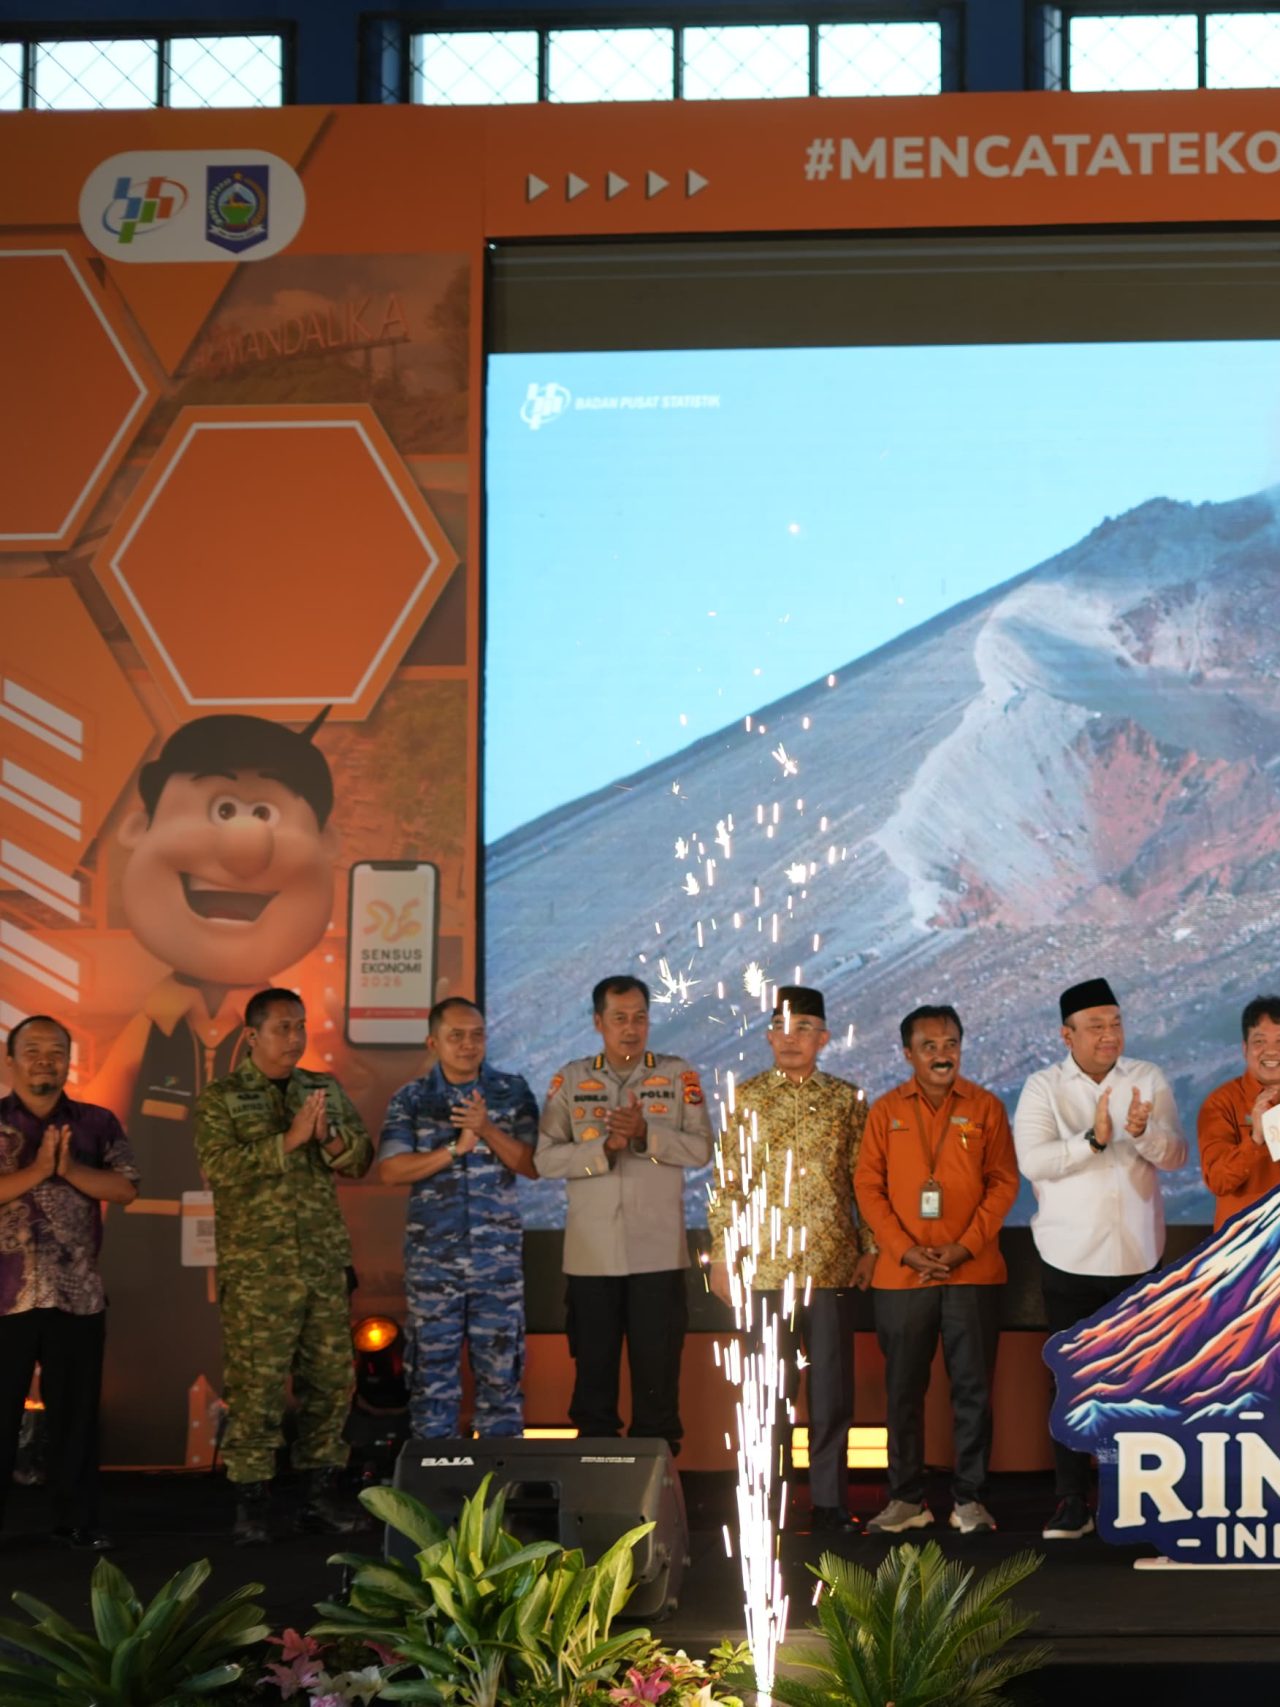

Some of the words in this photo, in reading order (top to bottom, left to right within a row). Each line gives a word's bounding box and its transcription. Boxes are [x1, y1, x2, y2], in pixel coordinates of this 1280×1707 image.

[227, 292, 411, 362] MANDALIKA
[361, 949, 423, 961] SENSUS
[361, 962, 421, 974] EKONOMI
[361, 976, 403, 988] 2026
[640, 1091, 675, 1099] POLRI
[421, 1457, 474, 1467] BAJA
